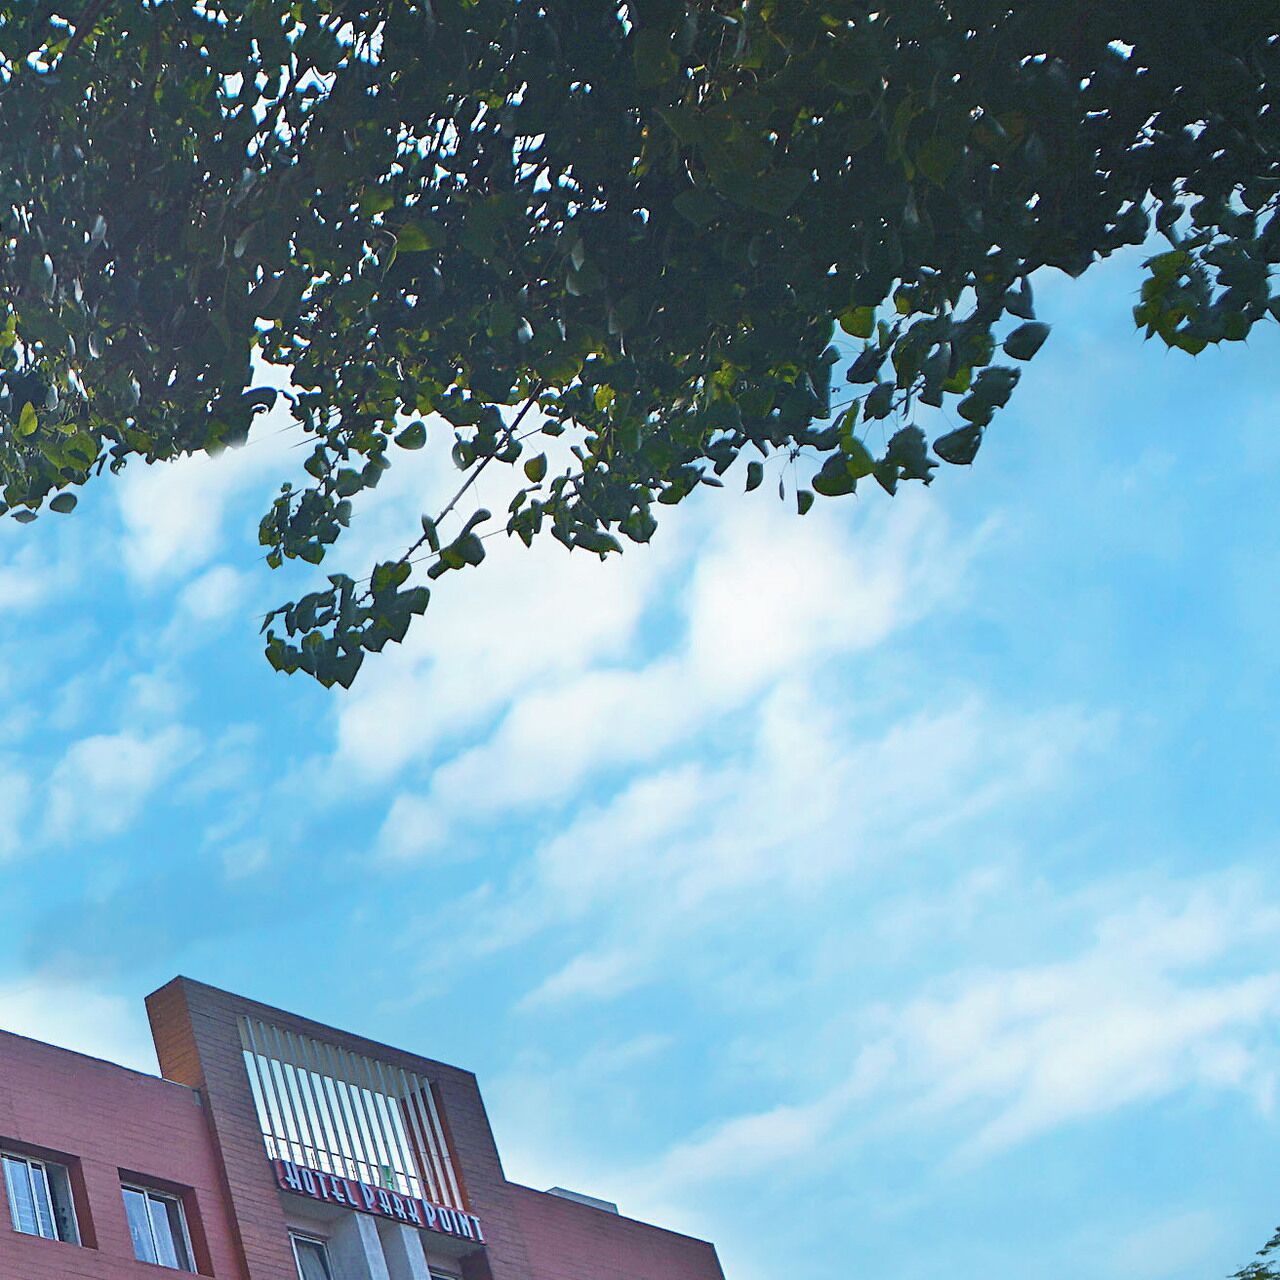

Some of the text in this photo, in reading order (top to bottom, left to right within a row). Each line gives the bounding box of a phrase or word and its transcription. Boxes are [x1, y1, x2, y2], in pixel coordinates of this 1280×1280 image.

[283, 1160, 484, 1241] HOTEL PARK POINT
